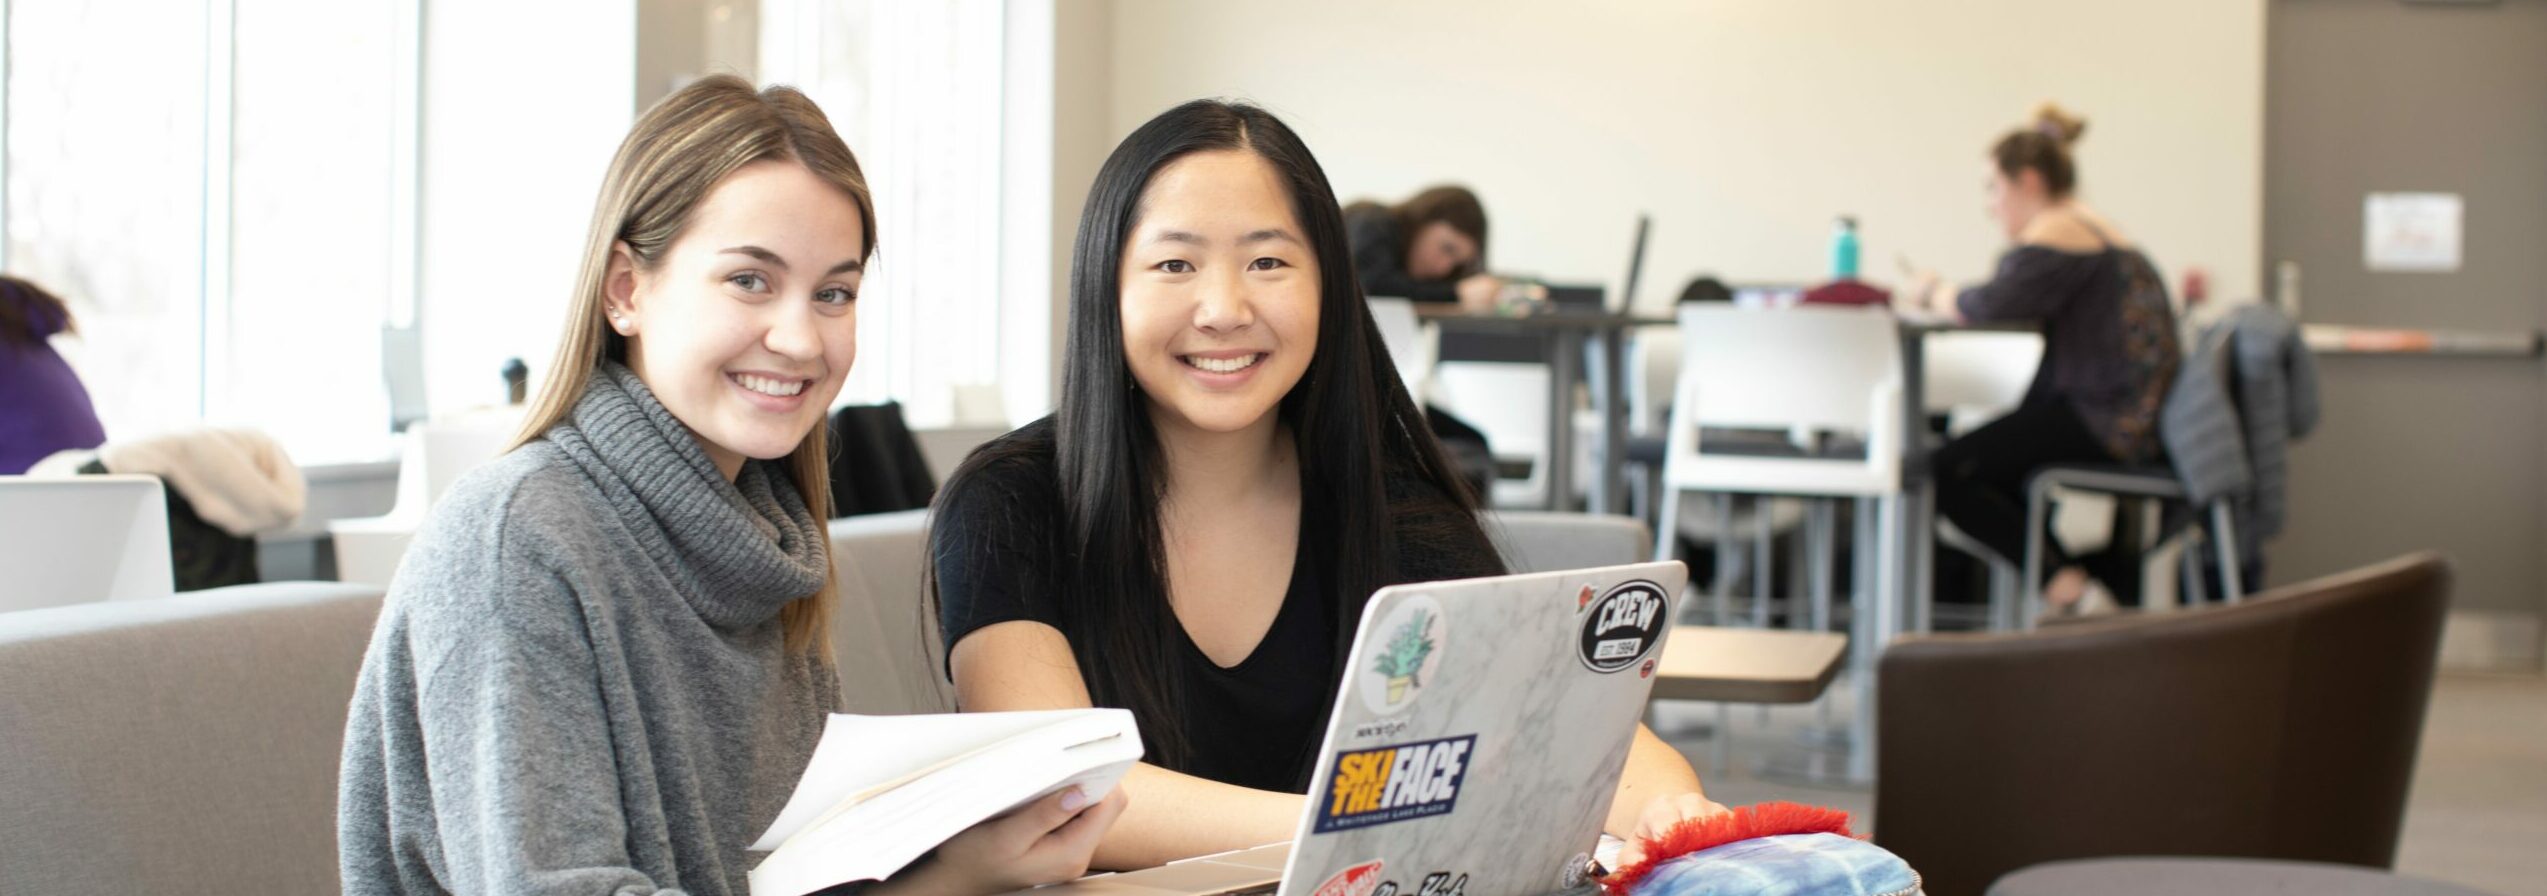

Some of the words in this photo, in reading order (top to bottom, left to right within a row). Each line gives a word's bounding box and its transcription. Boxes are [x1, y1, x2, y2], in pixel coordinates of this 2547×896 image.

[1595, 590, 1660, 636] CREW
[1335, 749, 1397, 788] SKI
[1380, 739, 1470, 809] FACE
[1330, 782, 1384, 817] THE
